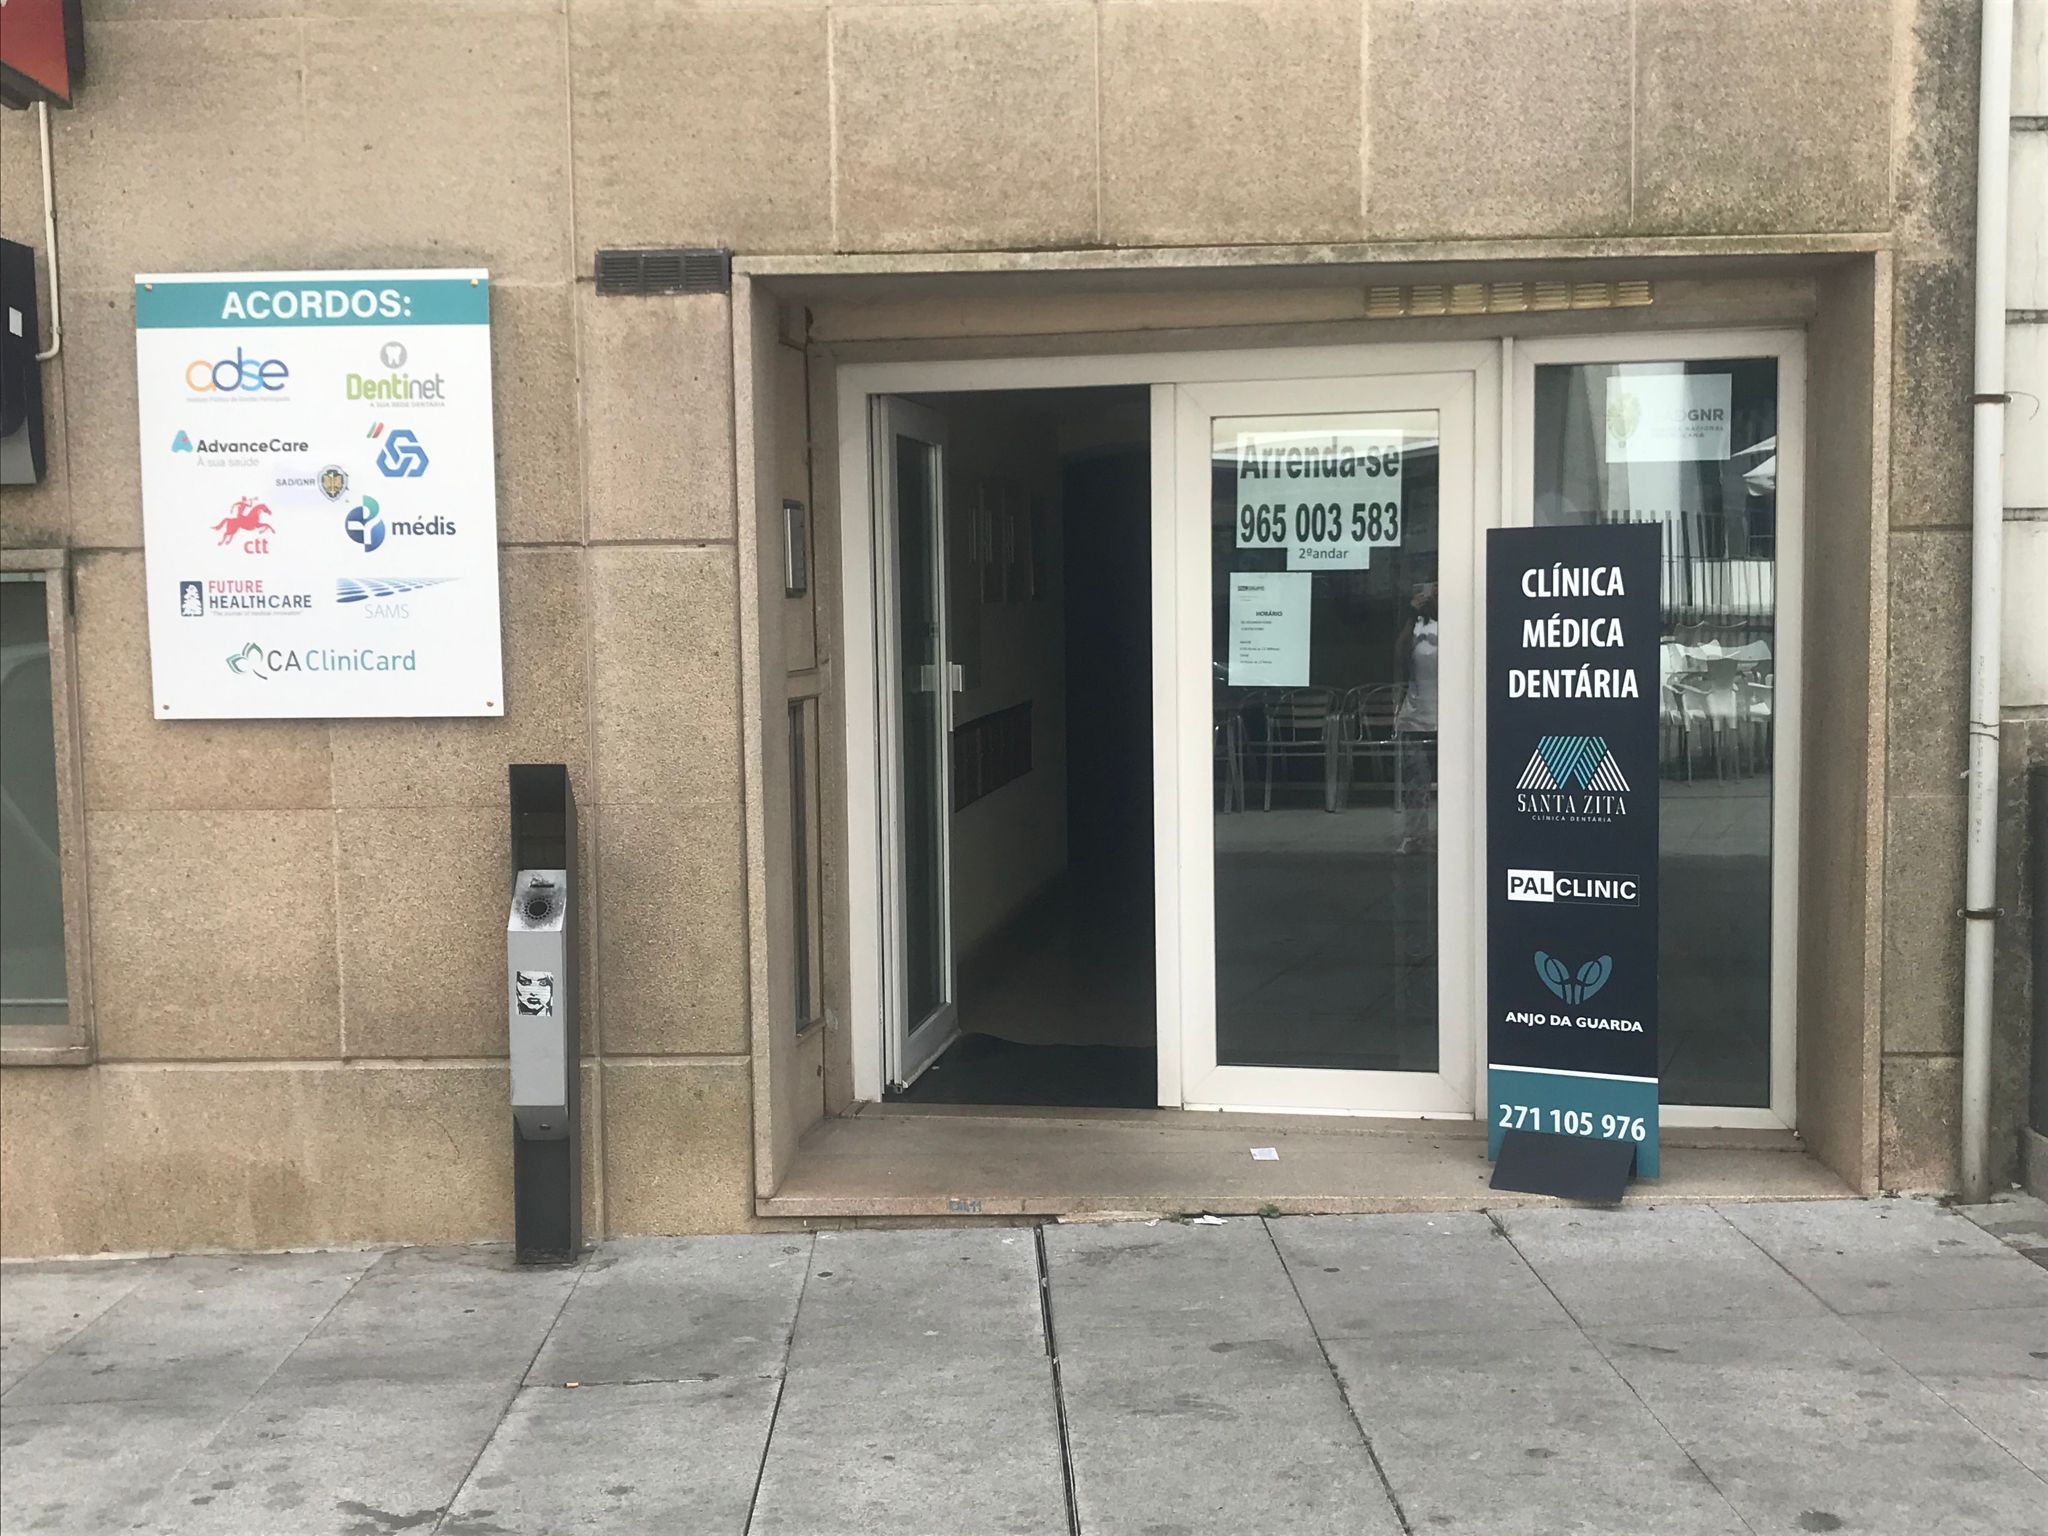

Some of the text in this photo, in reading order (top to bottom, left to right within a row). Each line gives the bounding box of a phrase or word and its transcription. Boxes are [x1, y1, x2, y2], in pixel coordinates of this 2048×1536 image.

[221, 289, 412, 319] ACORDOS:
[184, 346, 289, 392] adse
[346, 372, 446, 401] Dentinet
[196, 439, 309, 453] AdvanceCare
[1240, 436, 1400, 479] Arrenda-se
[391, 515, 457, 536] médis
[1240, 502, 1399, 543] 965 003 583
[243, 539, 269, 554] ctt
[208, 580, 263, 594] FUTURE
[1521, 562, 1625, 598] CLÍNICA
[209, 595, 312, 609] HEALTHCARE
[364, 603, 410, 620] SAMS
[1522, 612, 1624, 648] MÉDICA
[267, 649, 416, 671] CA CliniCard
[1508, 663, 1639, 698] DENTÁRIA
[1517, 793, 1627, 815] SANTA ZITA
[1505, 1011, 1644, 1033] ANJO DA GUARDA
[1499, 1103, 1646, 1142] 271 105 976
